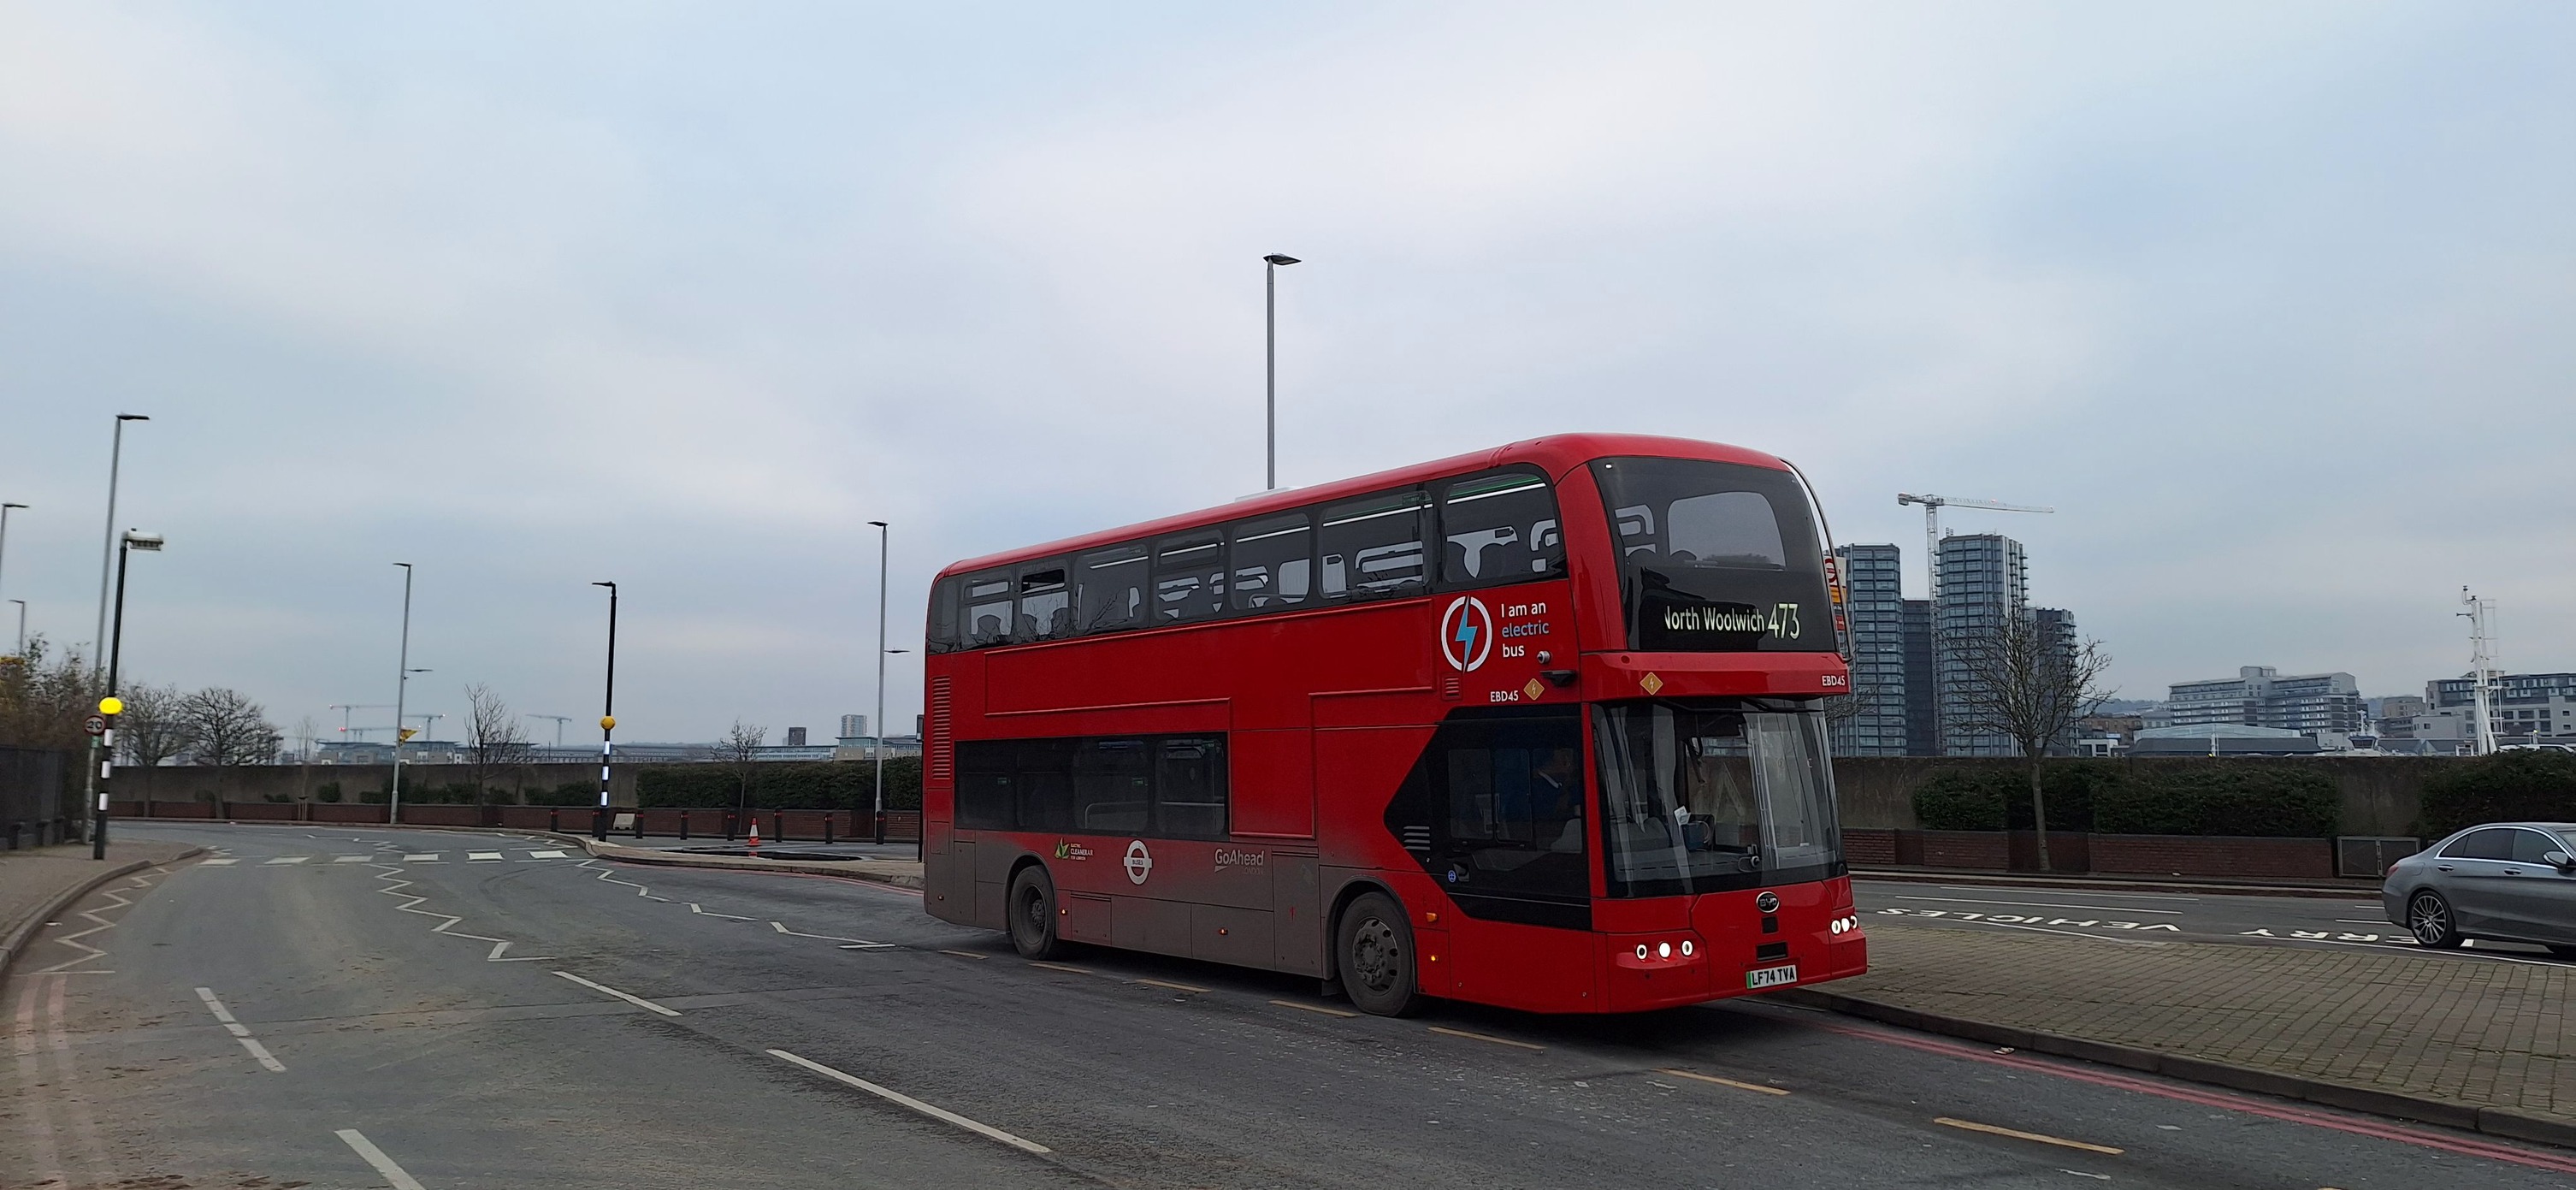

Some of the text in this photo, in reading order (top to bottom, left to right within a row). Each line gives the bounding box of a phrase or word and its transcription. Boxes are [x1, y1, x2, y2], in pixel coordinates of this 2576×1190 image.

[1501, 601, 1546, 618] I am an
[1502, 620, 1550, 637] electric
[1703, 607, 1765, 632] Woolwich
[1768, 603, 1799, 639] 473
[1503, 643, 1525, 658] bus
[1822, 675, 1846, 686] EBD45
[1490, 690, 1519, 702] EBD45
[87, 720, 103, 730] 20
[1215, 849, 1265, 866] GoAhead
[1759, 897, 1777, 907] BYD
[1877, 908, 2180, 932] VEHICLES
[1752, 967, 1795, 986] LF74 TVA
